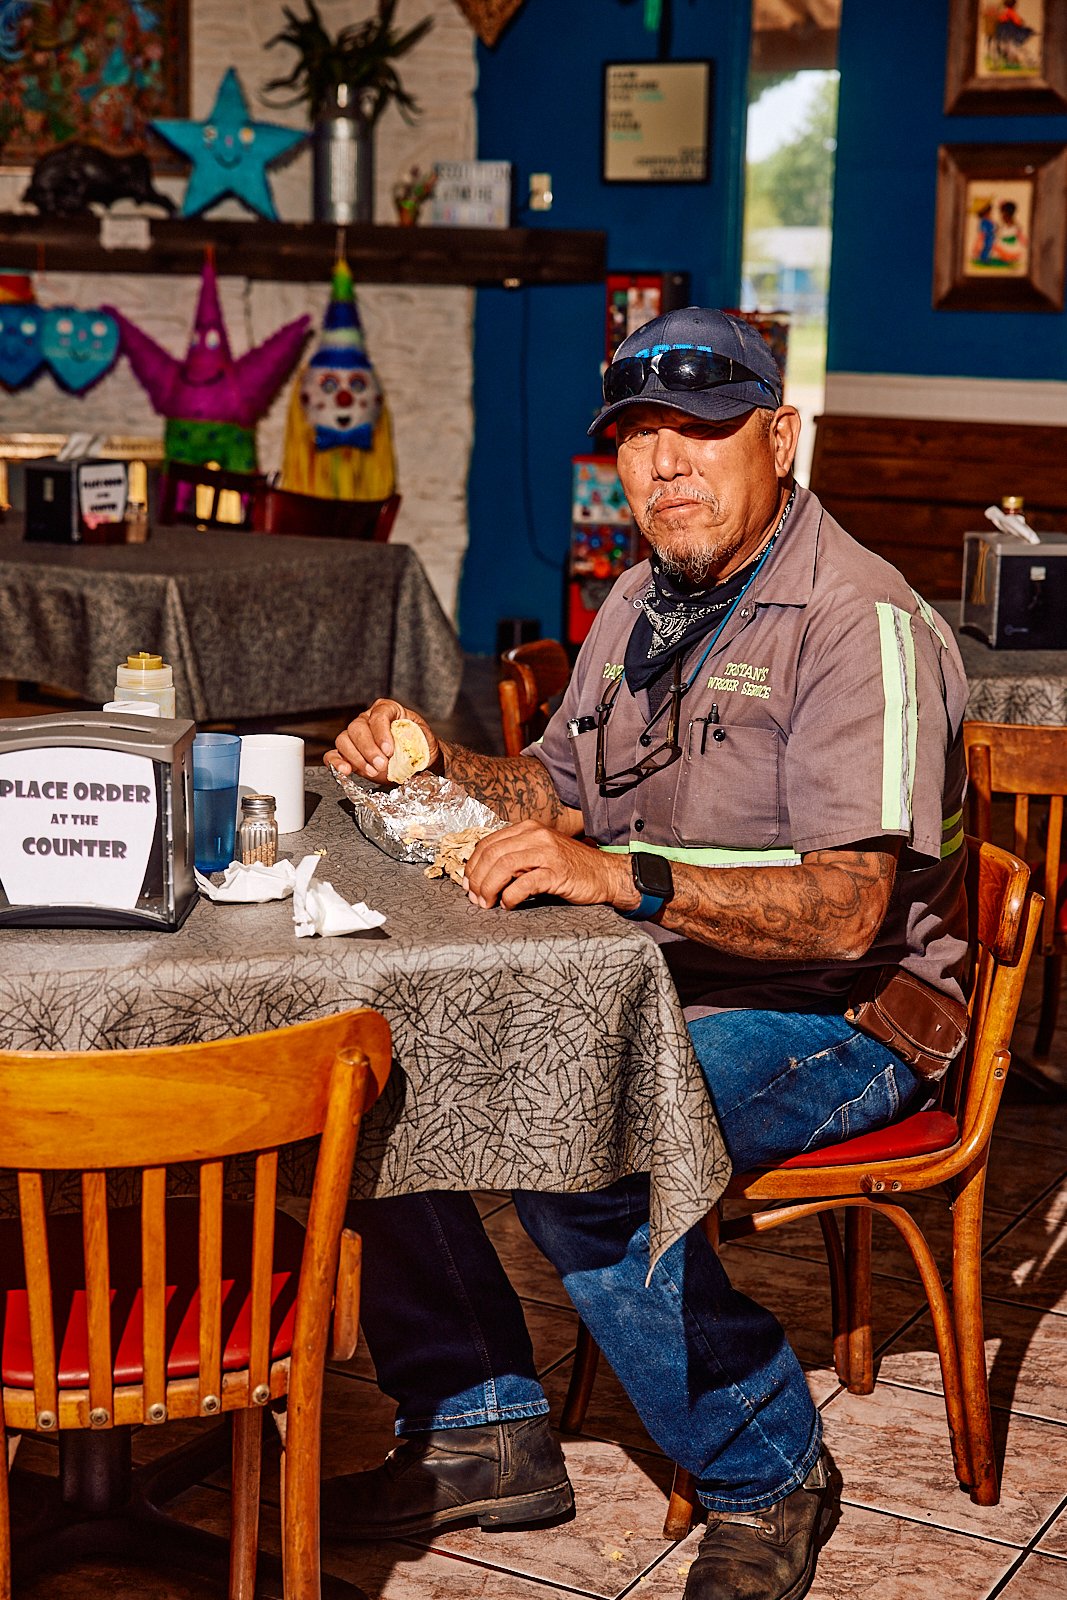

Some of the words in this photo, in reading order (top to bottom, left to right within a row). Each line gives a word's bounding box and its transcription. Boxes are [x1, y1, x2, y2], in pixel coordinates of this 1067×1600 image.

[0, 779, 68, 800] PLACE
[73, 782, 151, 803] ORDER
[50, 813, 69, 825] AT
[71, 814, 99, 826] THE
[22, 836, 127, 859] COUNTER
